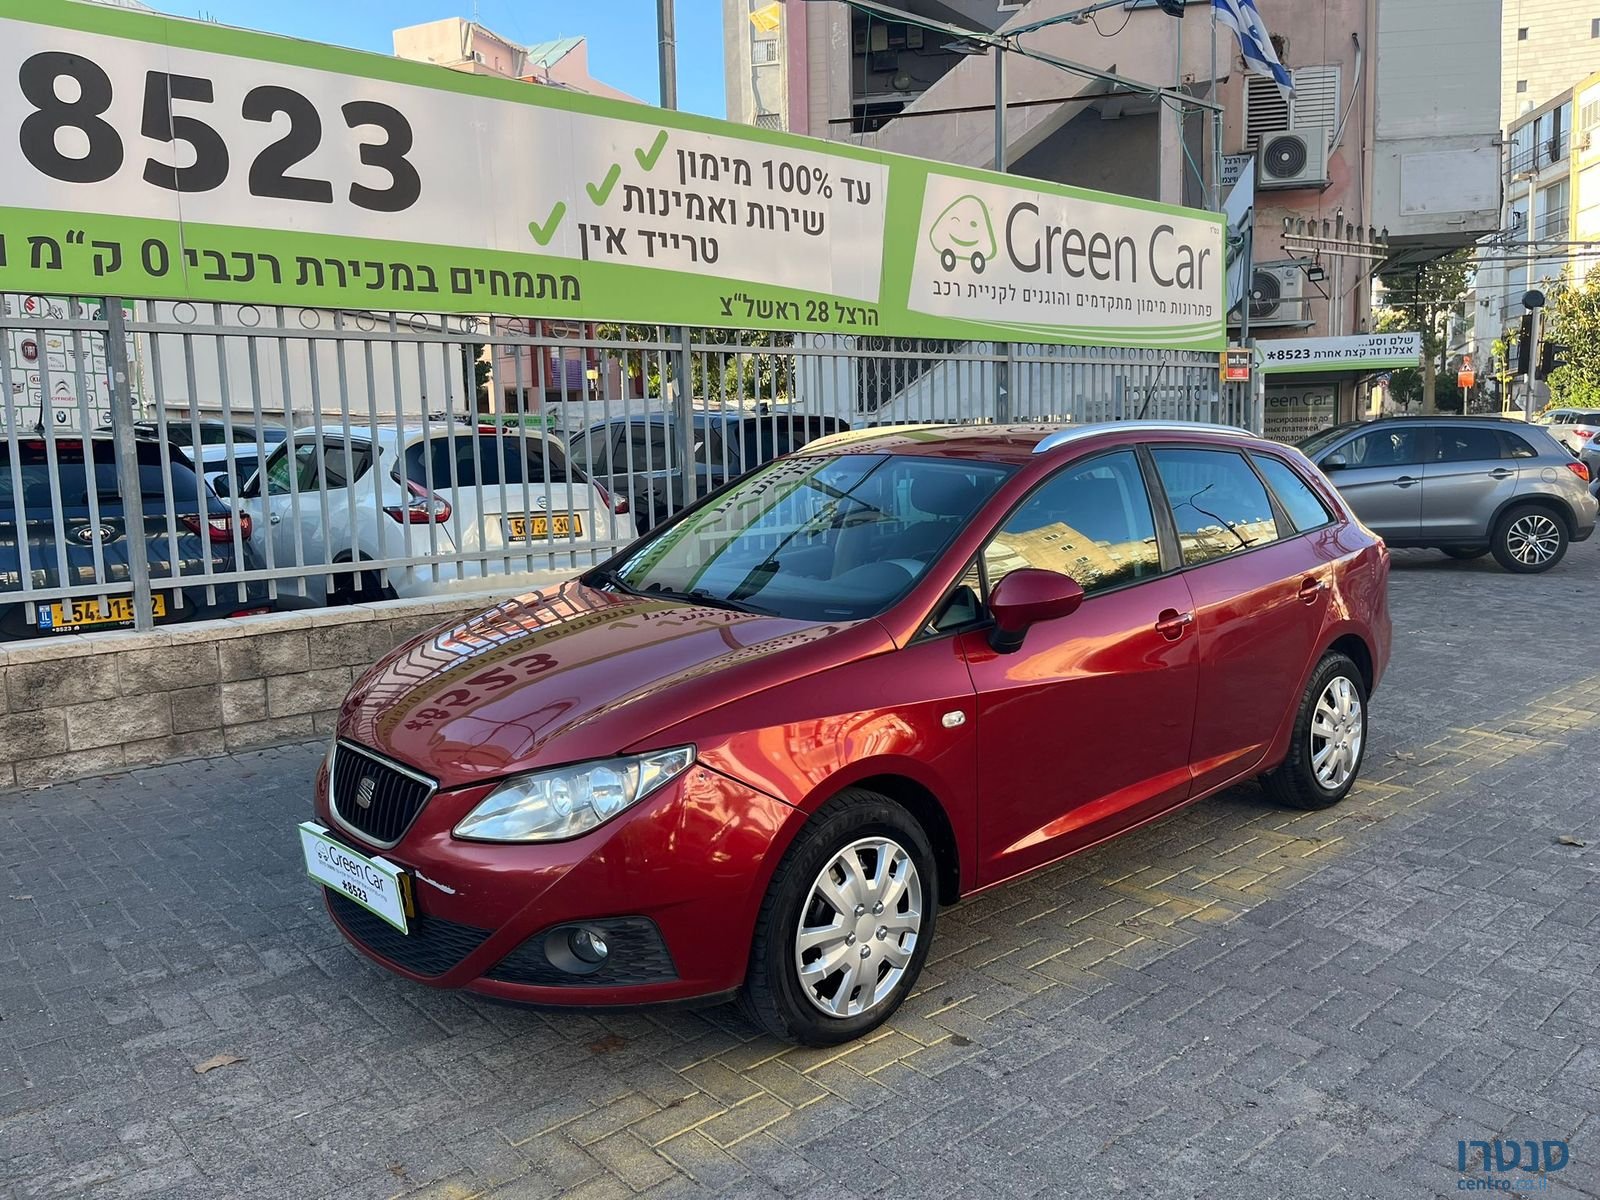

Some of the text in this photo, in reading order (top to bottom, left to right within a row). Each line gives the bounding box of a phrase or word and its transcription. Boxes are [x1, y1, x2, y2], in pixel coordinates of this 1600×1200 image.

[18, 51, 422, 213] 8523
[676, 149, 872, 205] עד 100% מימון
[622, 184, 825, 236] שירות ואמינות
[27, 229, 122, 277] ק"מ
[578, 223, 719, 263] טרייד אין
[1005, 201, 1211, 290] Green Car
[184, 248, 282, 284] רכבי
[295, 256, 439, 293] במכירת
[450, 266, 581, 301] מתמחים
[719, 292, 878, 326] הרצל 28 ראשל"צ
[932, 280, 1212, 317] פתרונות מימון מתקדמים והוגנים לקניית רכב
[1344, 349, 1366, 358] קצת
[1369, 347, 1381, 356] זה
[1384, 346, 1413, 355] אצלנו
[1390, 336, 1414, 345] שלם
[1264, 392, 1329, 408] reen Car
[1264, 416, 1317, 426] ансирование
[329, 846, 364, 880] Green
[364, 866, 384, 892] Car
